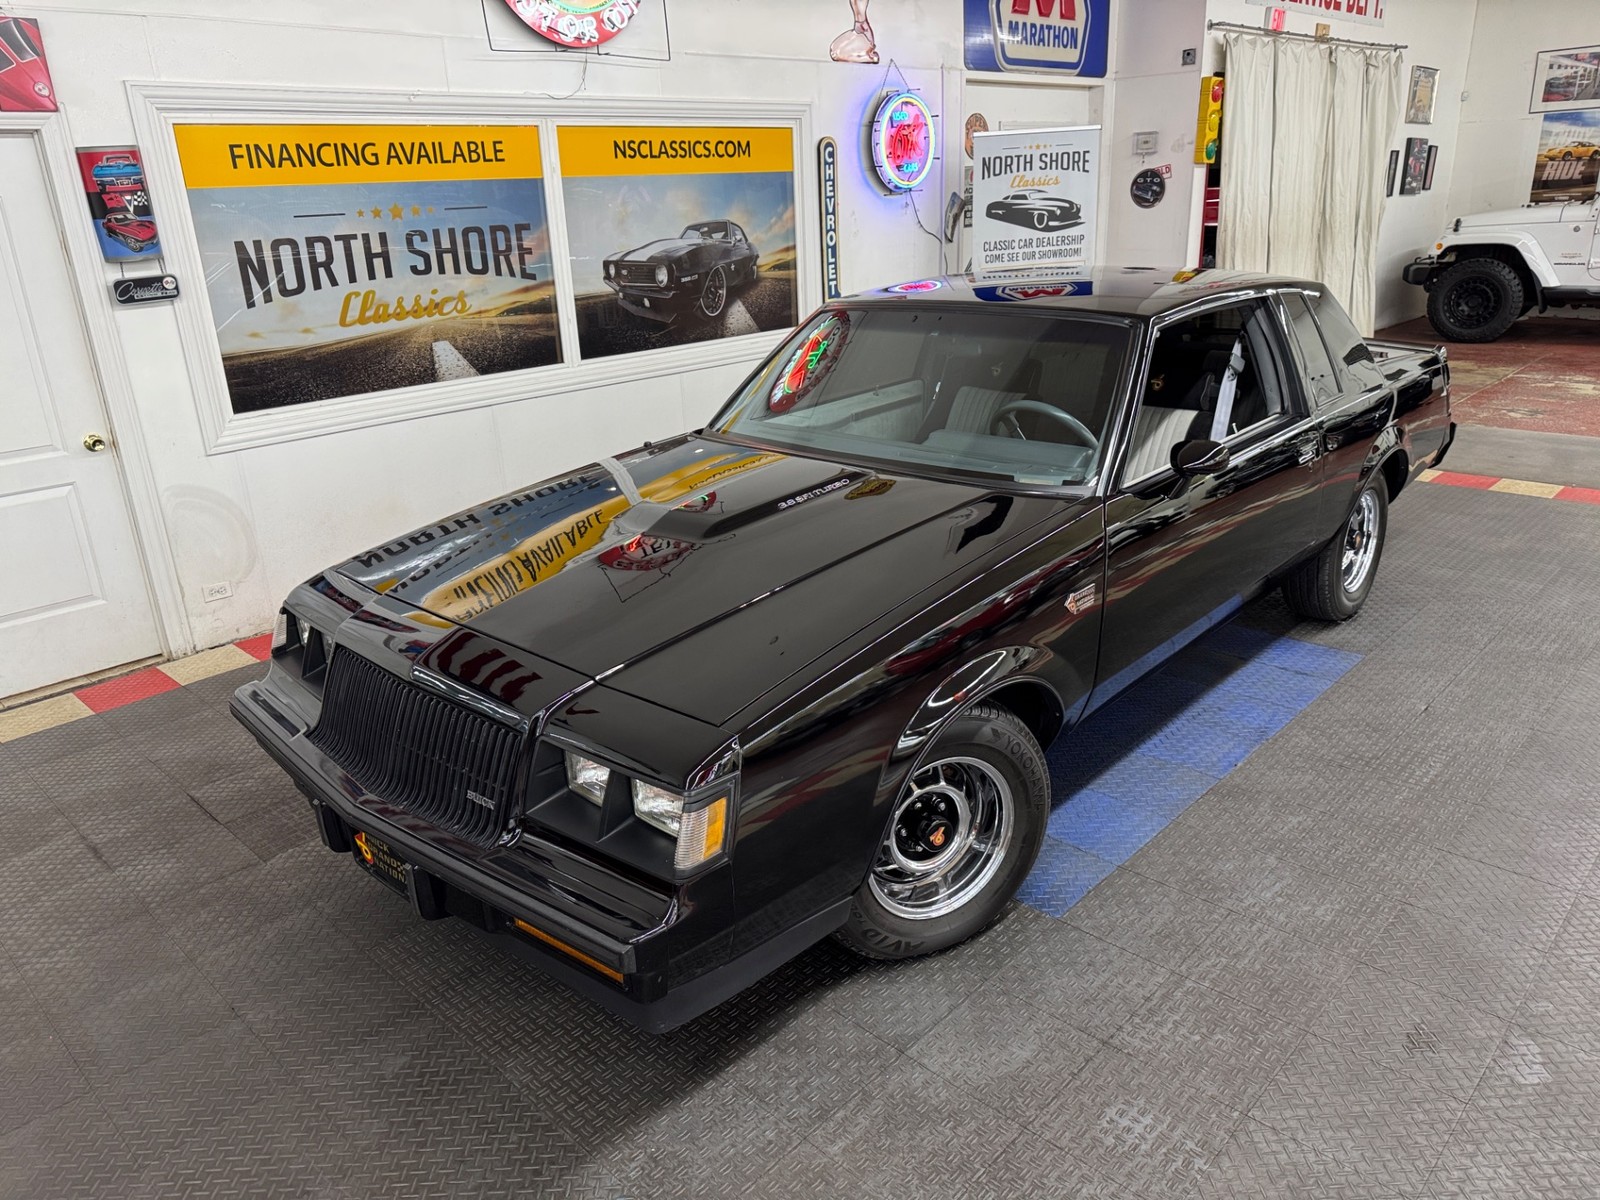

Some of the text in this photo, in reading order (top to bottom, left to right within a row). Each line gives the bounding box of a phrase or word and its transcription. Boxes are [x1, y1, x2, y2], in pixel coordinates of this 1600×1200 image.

[1008, 20, 1079, 50] MARATHON
[228, 140, 506, 171] FINANCING AVAILABLE
[613, 139, 752, 161] NSCLASSICS.COM
[981, 150, 1090, 181] NORTH SHORE
[1541, 161, 1586, 181] RIDE
[1010, 173, 1061, 189] Classics
[824, 147, 837, 296] CHEVROLET
[983, 234, 1085, 253] CLASSIC CAR DEALERSHIP
[232, 221, 538, 310] NORTH SHORE
[984, 246, 1082, 264] COME SEE OUR SHOWROOM!
[338, 288, 472, 329] Classics
[812, 478, 850, 498] TURBO
[466, 789, 496, 811] BUICK
